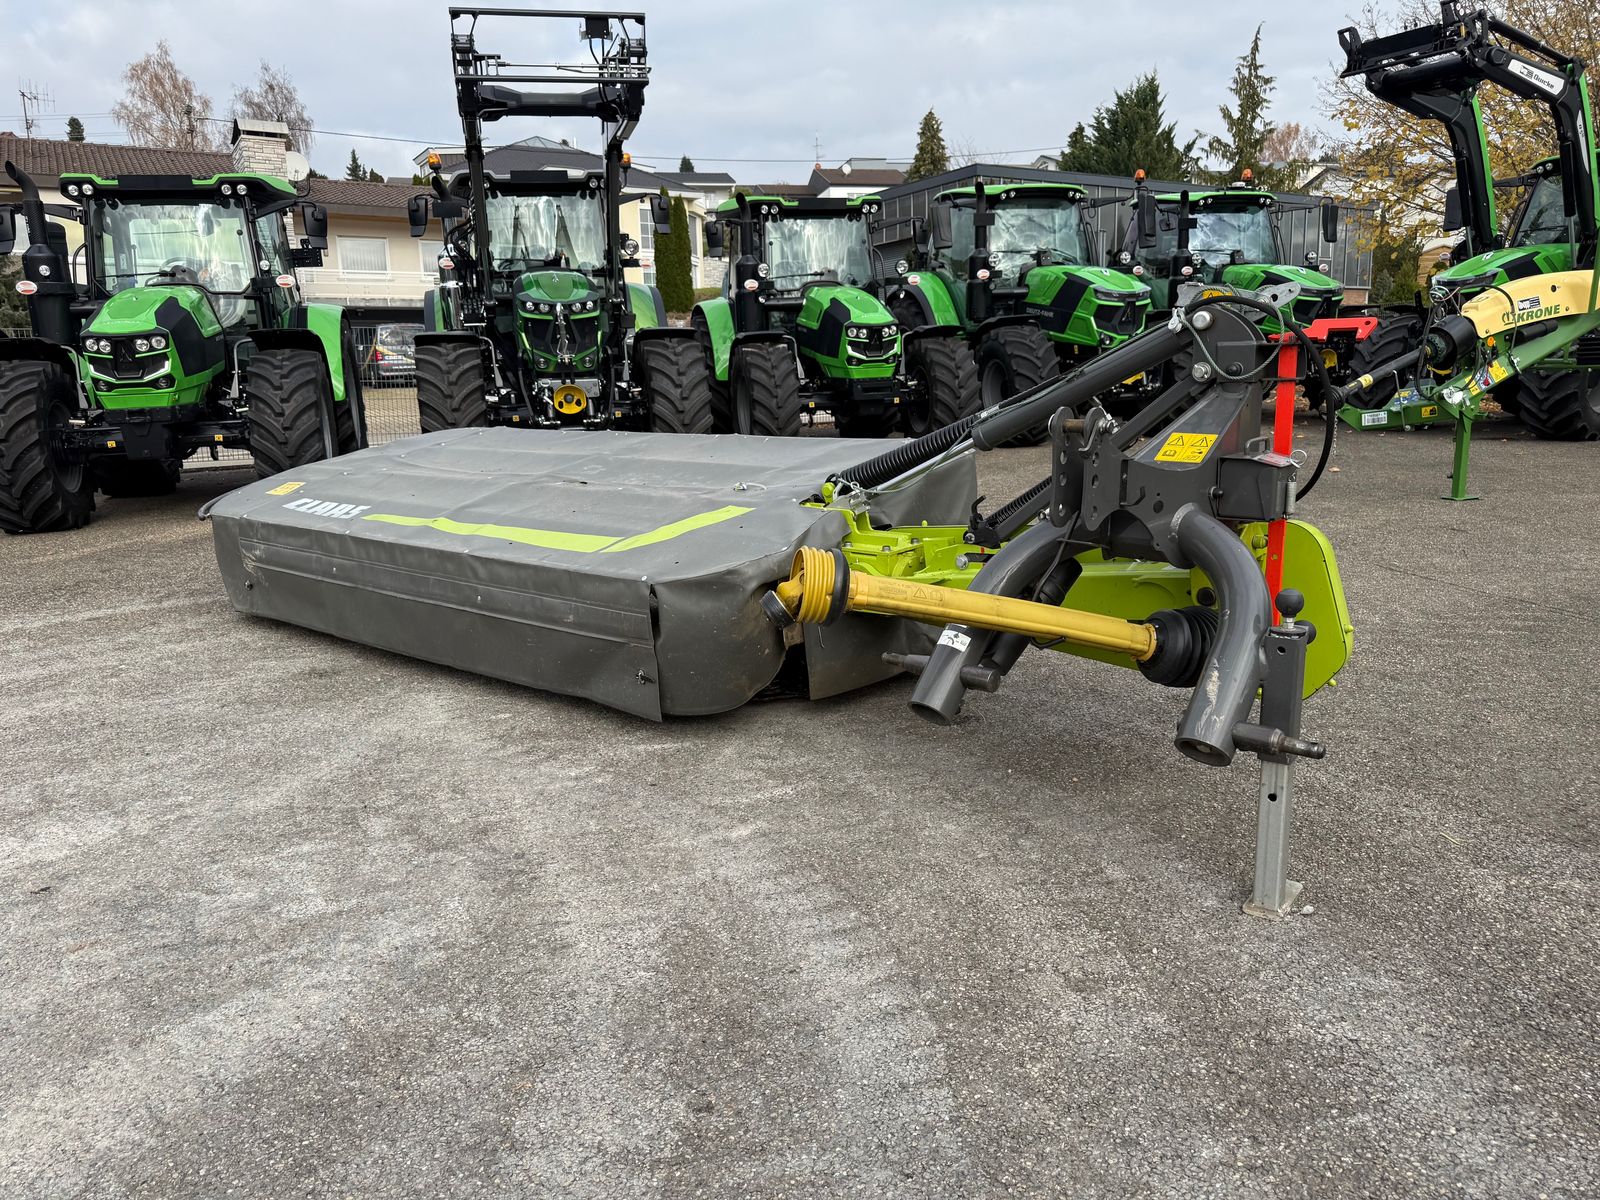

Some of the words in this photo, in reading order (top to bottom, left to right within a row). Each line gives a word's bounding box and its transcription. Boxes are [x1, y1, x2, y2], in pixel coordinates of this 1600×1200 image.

[1533, 73, 1555, 90] Quicke
[1516, 304, 1561, 323] KRONE
[282, 498, 372, 519] CLAAS
